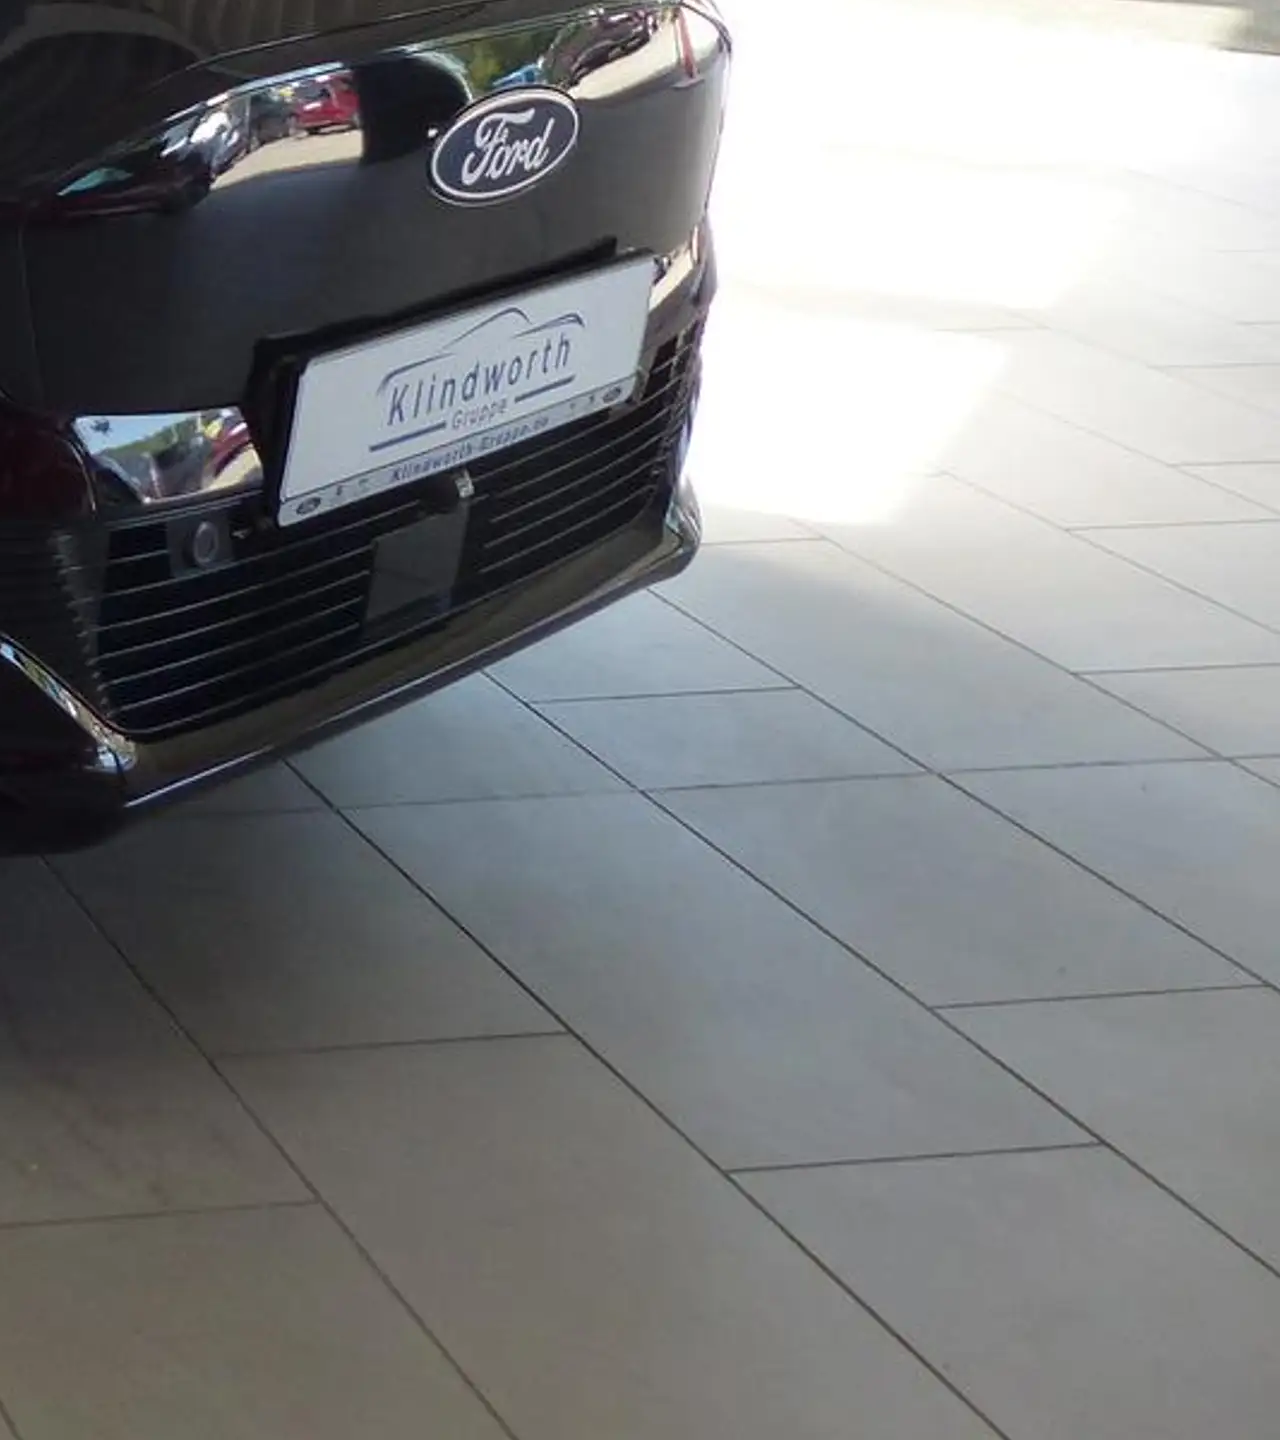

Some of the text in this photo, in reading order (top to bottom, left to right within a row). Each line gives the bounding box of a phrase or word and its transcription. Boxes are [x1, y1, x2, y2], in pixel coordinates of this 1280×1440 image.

[461, 108, 556, 186] Ford
[386, 333, 572, 426] Klindworth
[451, 397, 508, 431] Gruppe
